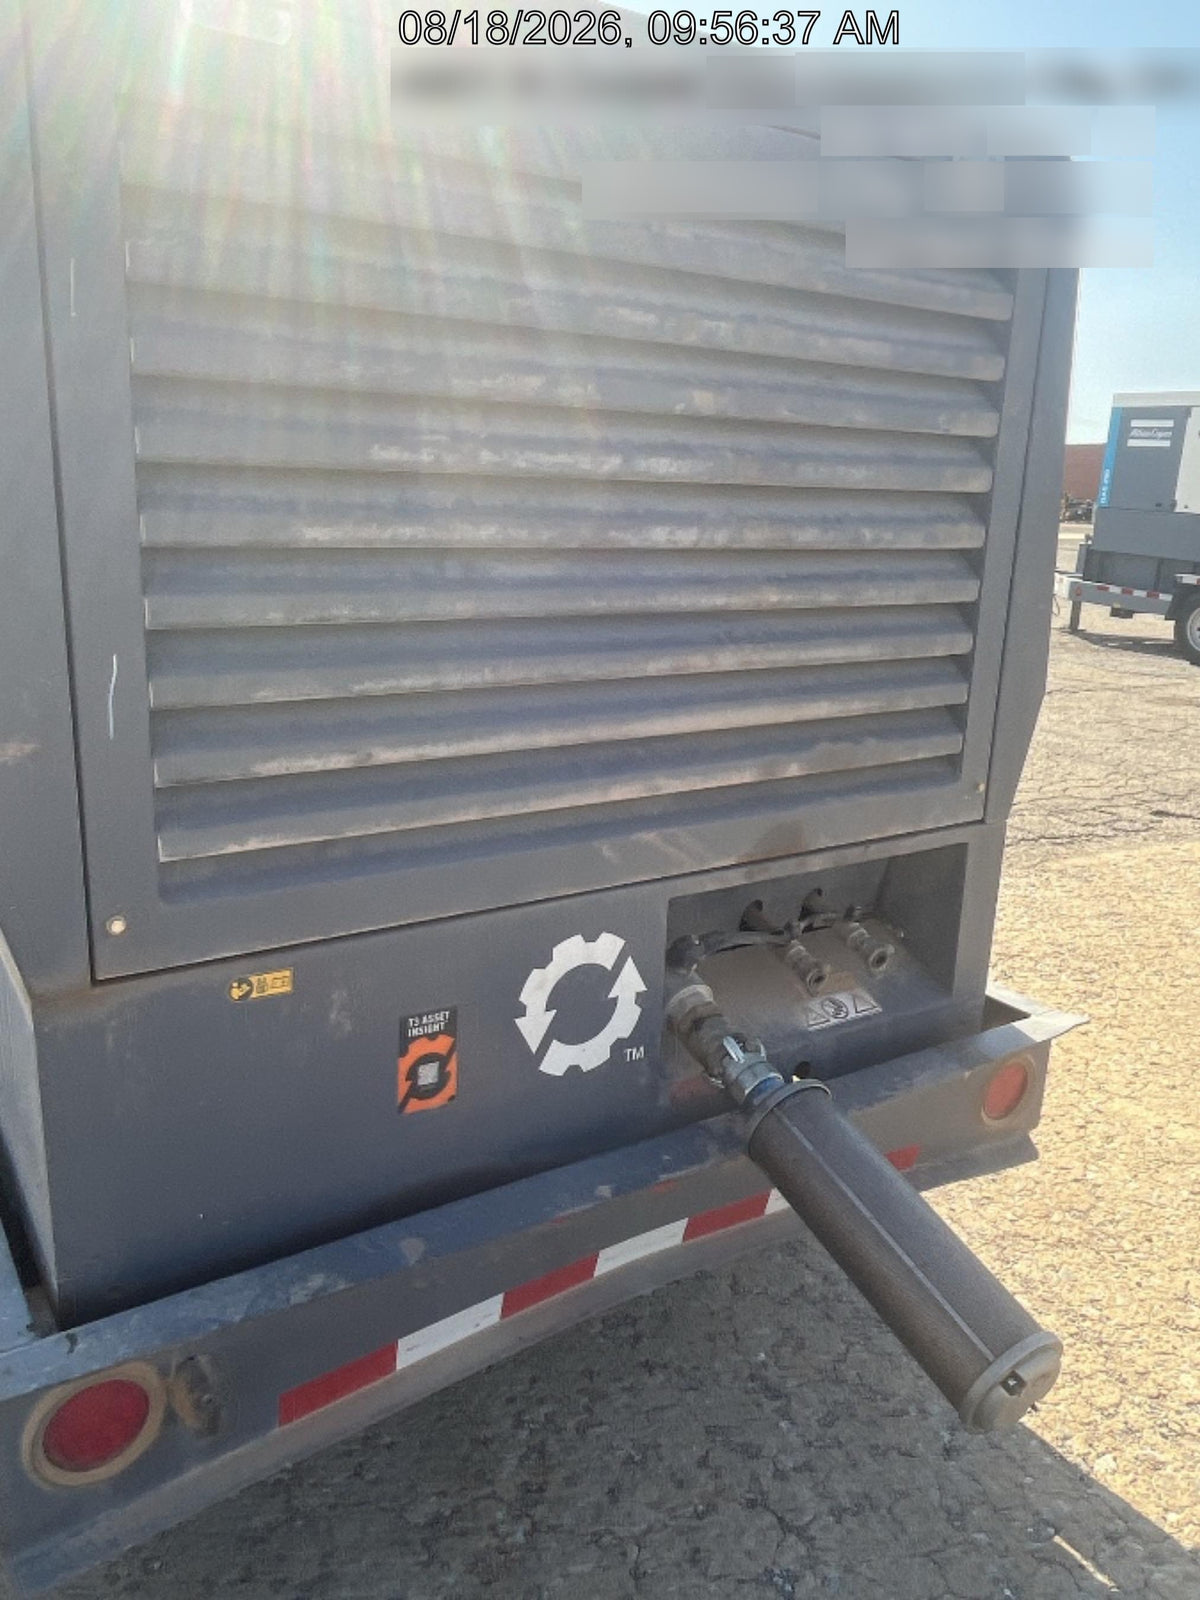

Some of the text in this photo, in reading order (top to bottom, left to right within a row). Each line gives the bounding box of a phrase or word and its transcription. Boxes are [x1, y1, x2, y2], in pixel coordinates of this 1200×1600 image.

[421, 1010, 450, 1025] ASSET
[408, 1022, 445, 1038] INSIGHT
[623, 1045, 645, 1062] TM
